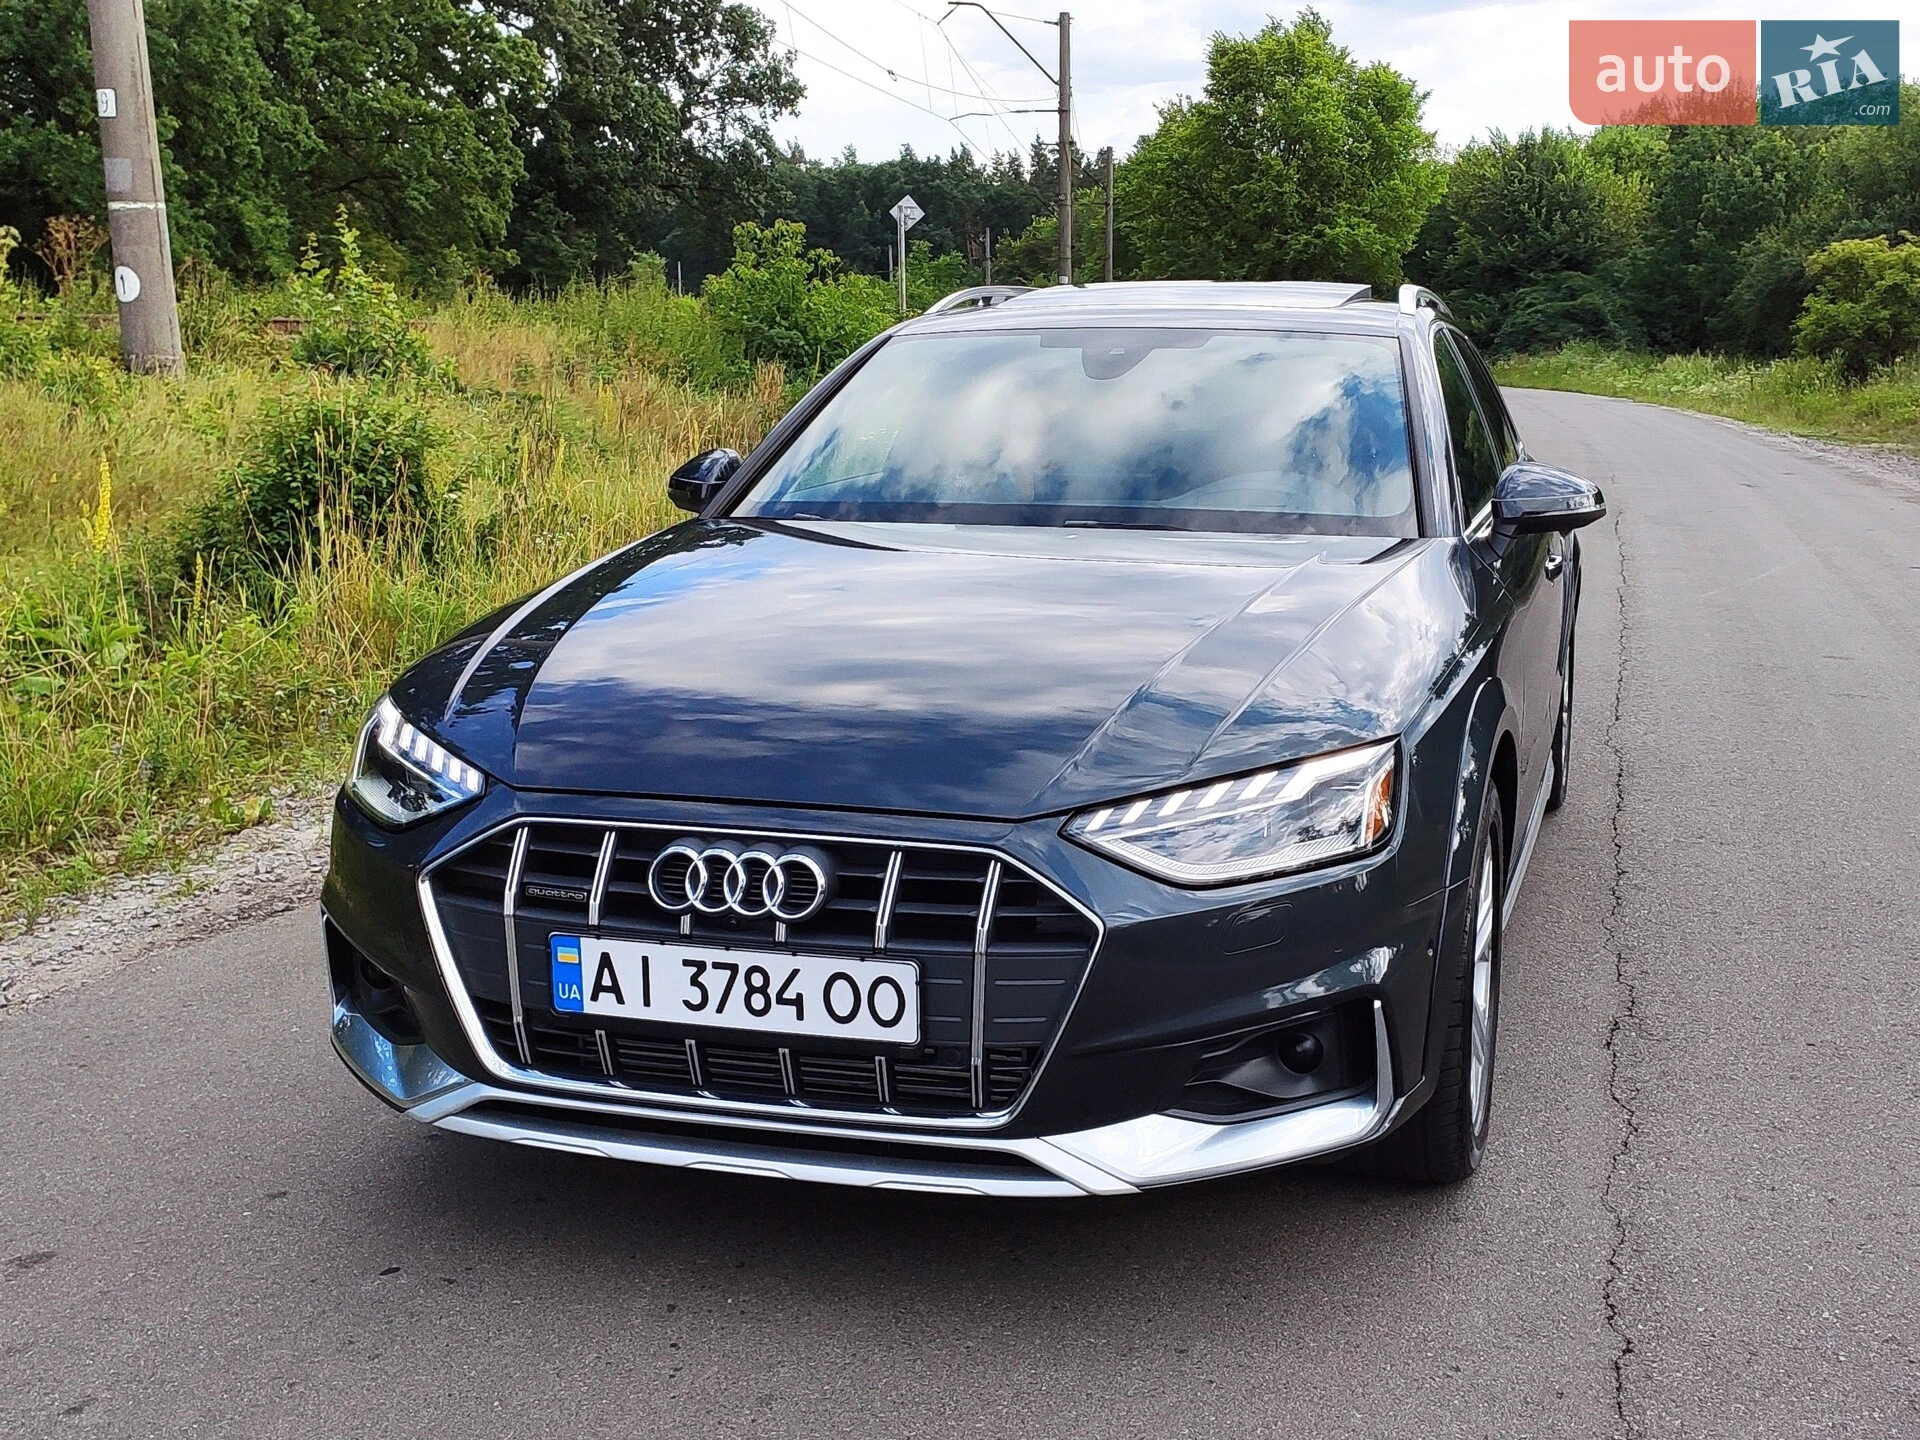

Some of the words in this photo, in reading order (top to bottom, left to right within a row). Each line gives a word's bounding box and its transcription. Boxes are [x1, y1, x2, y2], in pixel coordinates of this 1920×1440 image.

[528, 888, 584, 899] quattro
[558, 982, 581, 1000] UA
[590, 951, 651, 1008] AI
[682, 958, 804, 1021] 3784
[823, 971, 906, 1028] OO
